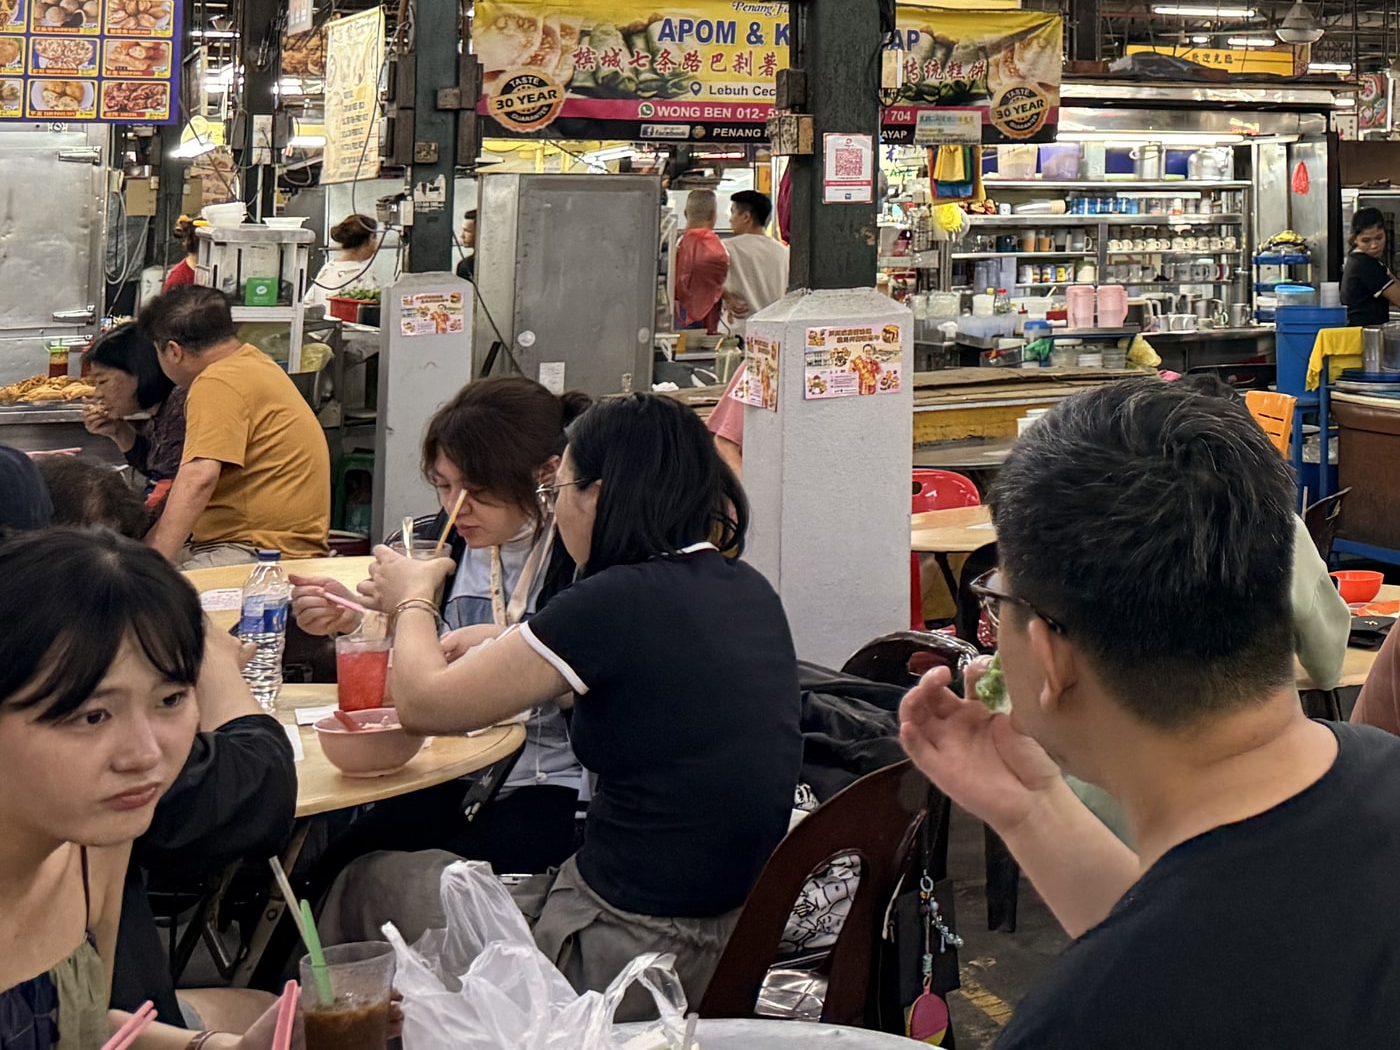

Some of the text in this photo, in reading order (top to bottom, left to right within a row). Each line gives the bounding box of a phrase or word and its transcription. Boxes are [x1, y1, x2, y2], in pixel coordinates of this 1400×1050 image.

[731, 1, 773, 16] Penang
[658, 18, 736, 44] APOM
[746, 22, 764, 45] &
[509, 76, 540, 87] TASTE
[709, 84, 748, 96] Lebuh
[1006, 89, 1031, 98] TASTE
[496, 90, 557, 110] 30 YEAR
[657, 106, 700, 118] WONG
[704, 107, 731, 119] BEN
[736, 108, 764, 119] 012-
[891, 111, 911, 121] 704
[996, 99, 1044, 119] 30 YEAR
[712, 128, 760, 137] PENANG
